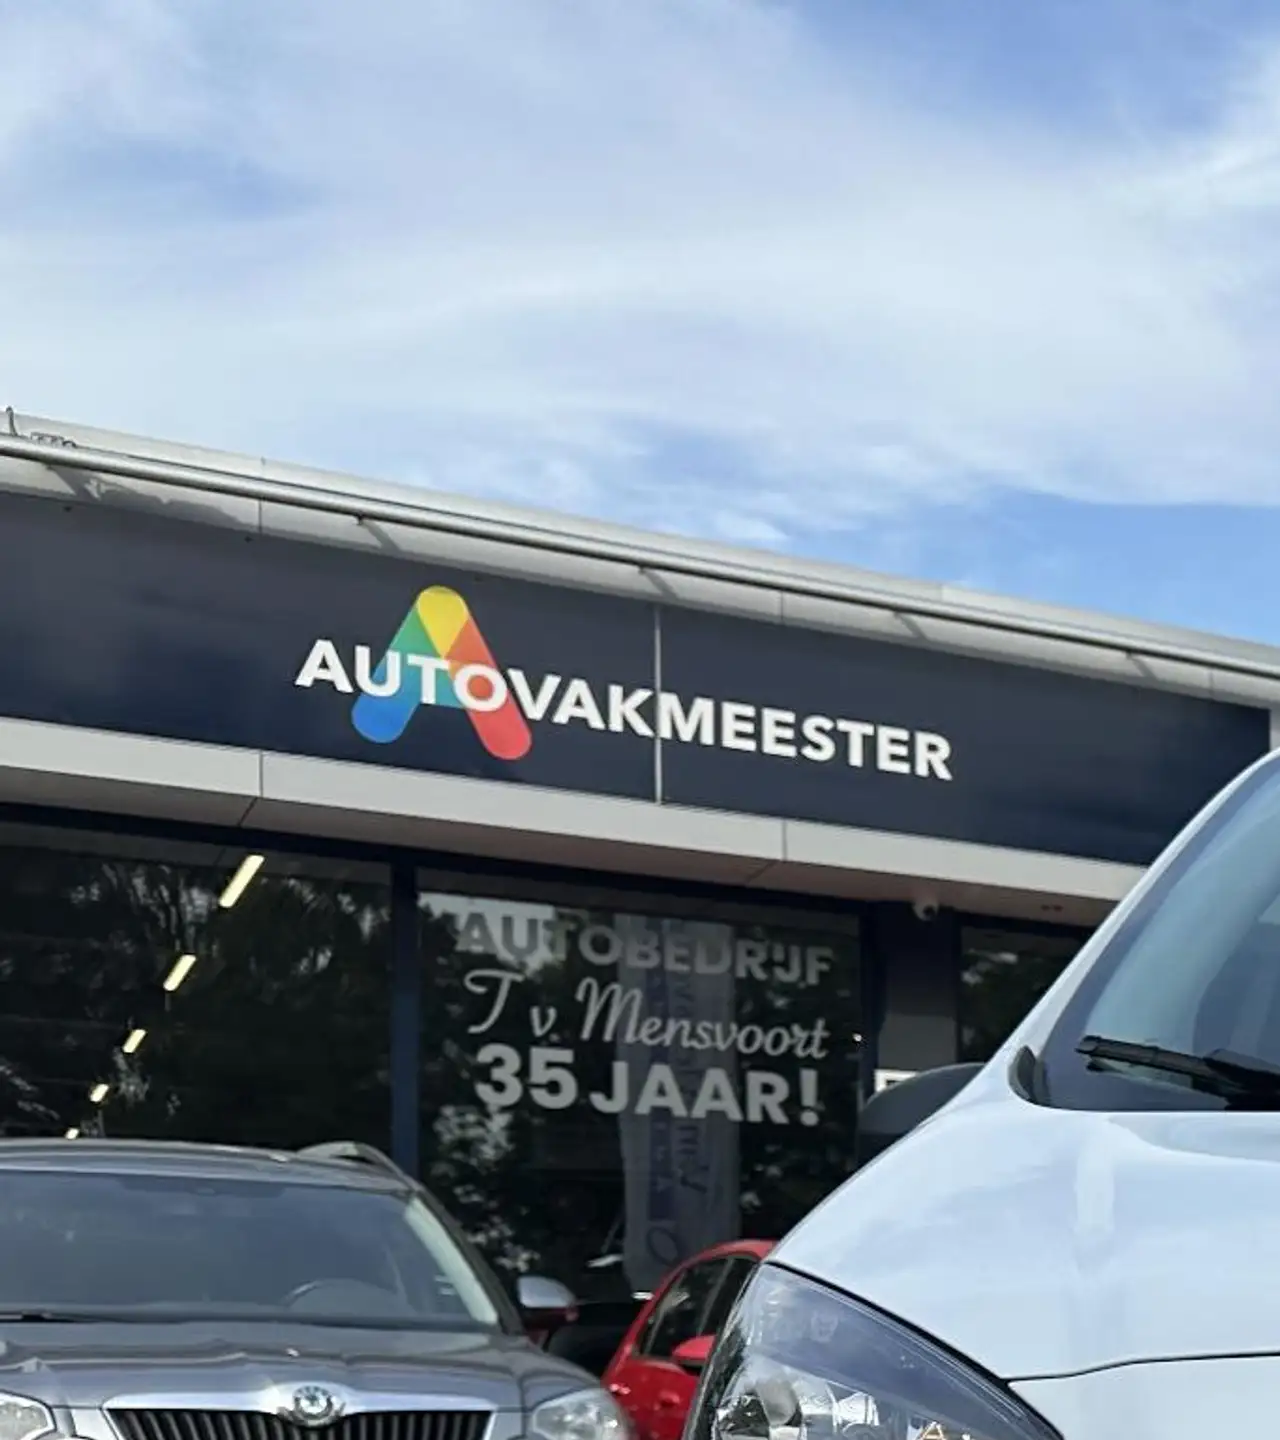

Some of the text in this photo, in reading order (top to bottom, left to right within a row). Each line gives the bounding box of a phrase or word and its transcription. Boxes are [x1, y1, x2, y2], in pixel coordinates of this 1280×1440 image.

[295, 638, 953, 780] AUTOVAKMEESTER
[455, 911, 833, 986] AUTOBEDRIJF
[529, 1005, 557, 1038] v
[575, 976, 831, 1059] Mensvoort
[475, 1042, 820, 1127] 35 JAAR!
